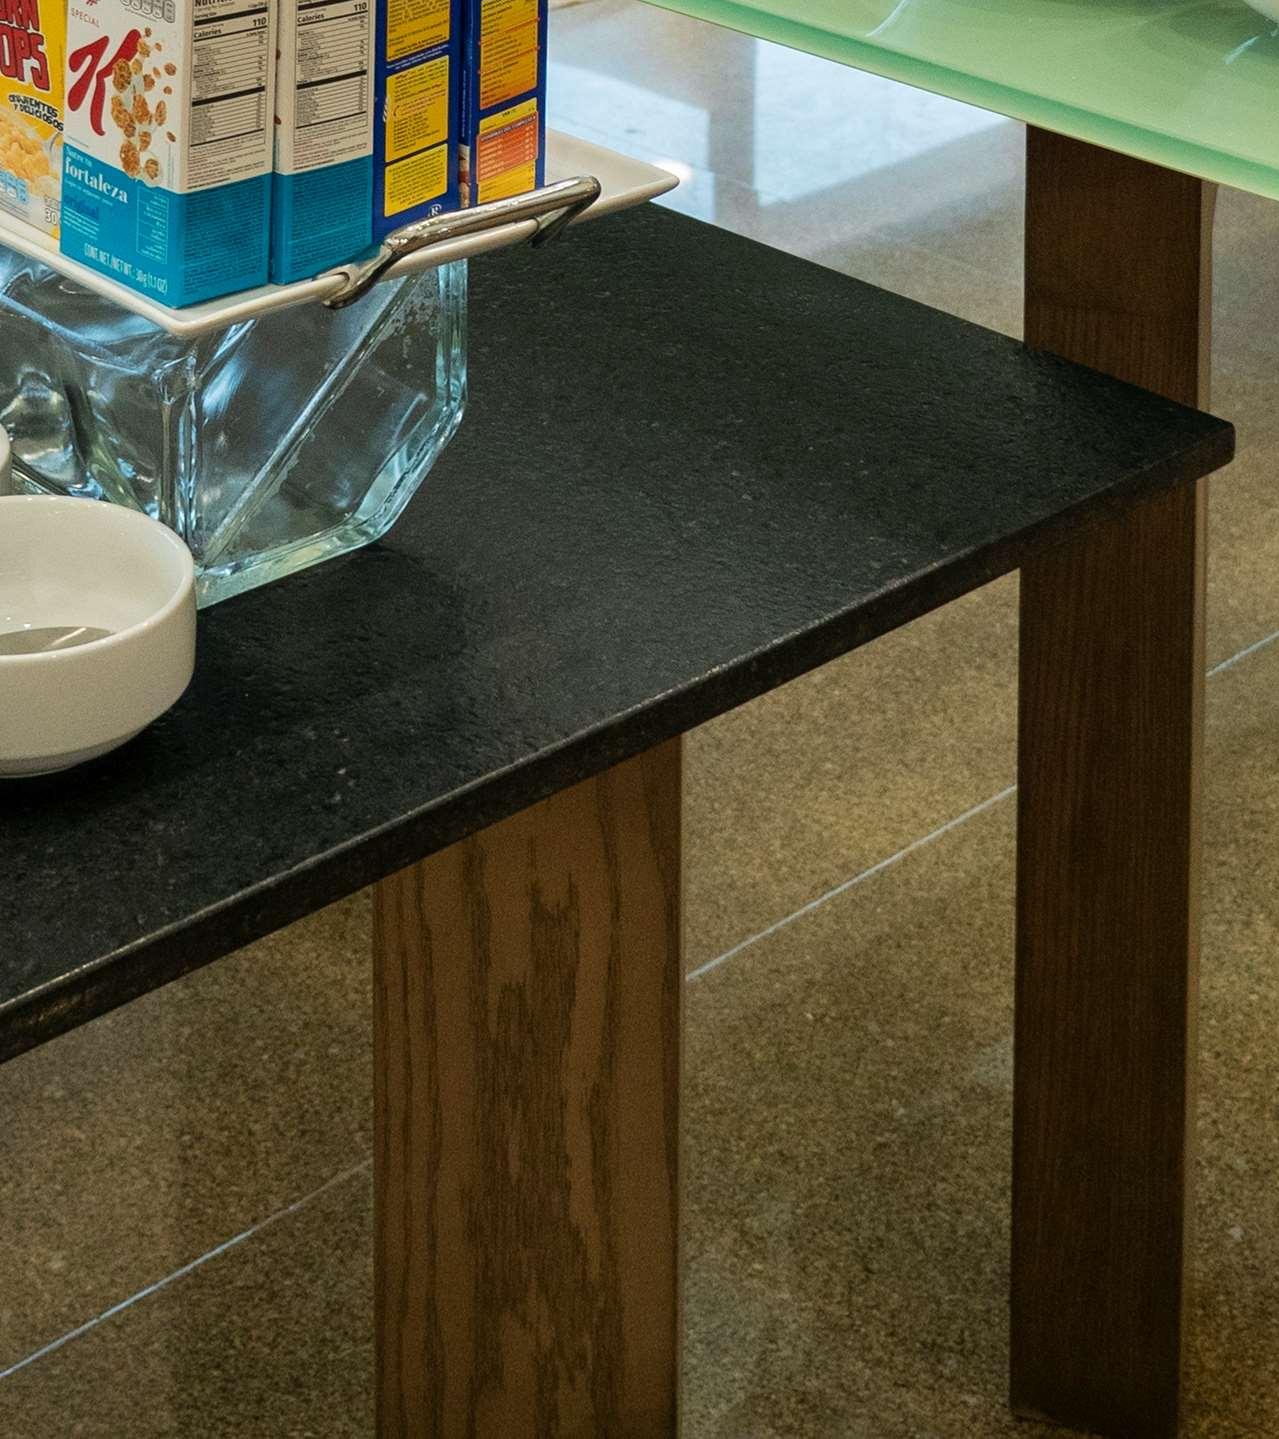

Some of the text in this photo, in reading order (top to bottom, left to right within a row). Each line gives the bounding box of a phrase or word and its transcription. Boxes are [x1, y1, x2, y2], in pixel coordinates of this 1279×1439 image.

[71, 7, 100, 29] SPECIAL
[297, 2, 367, 23] Calories 110
[193, 17, 267, 38] Calories 110
[67, 28, 142, 137] K
[64, 156, 129, 204] fortaleza
